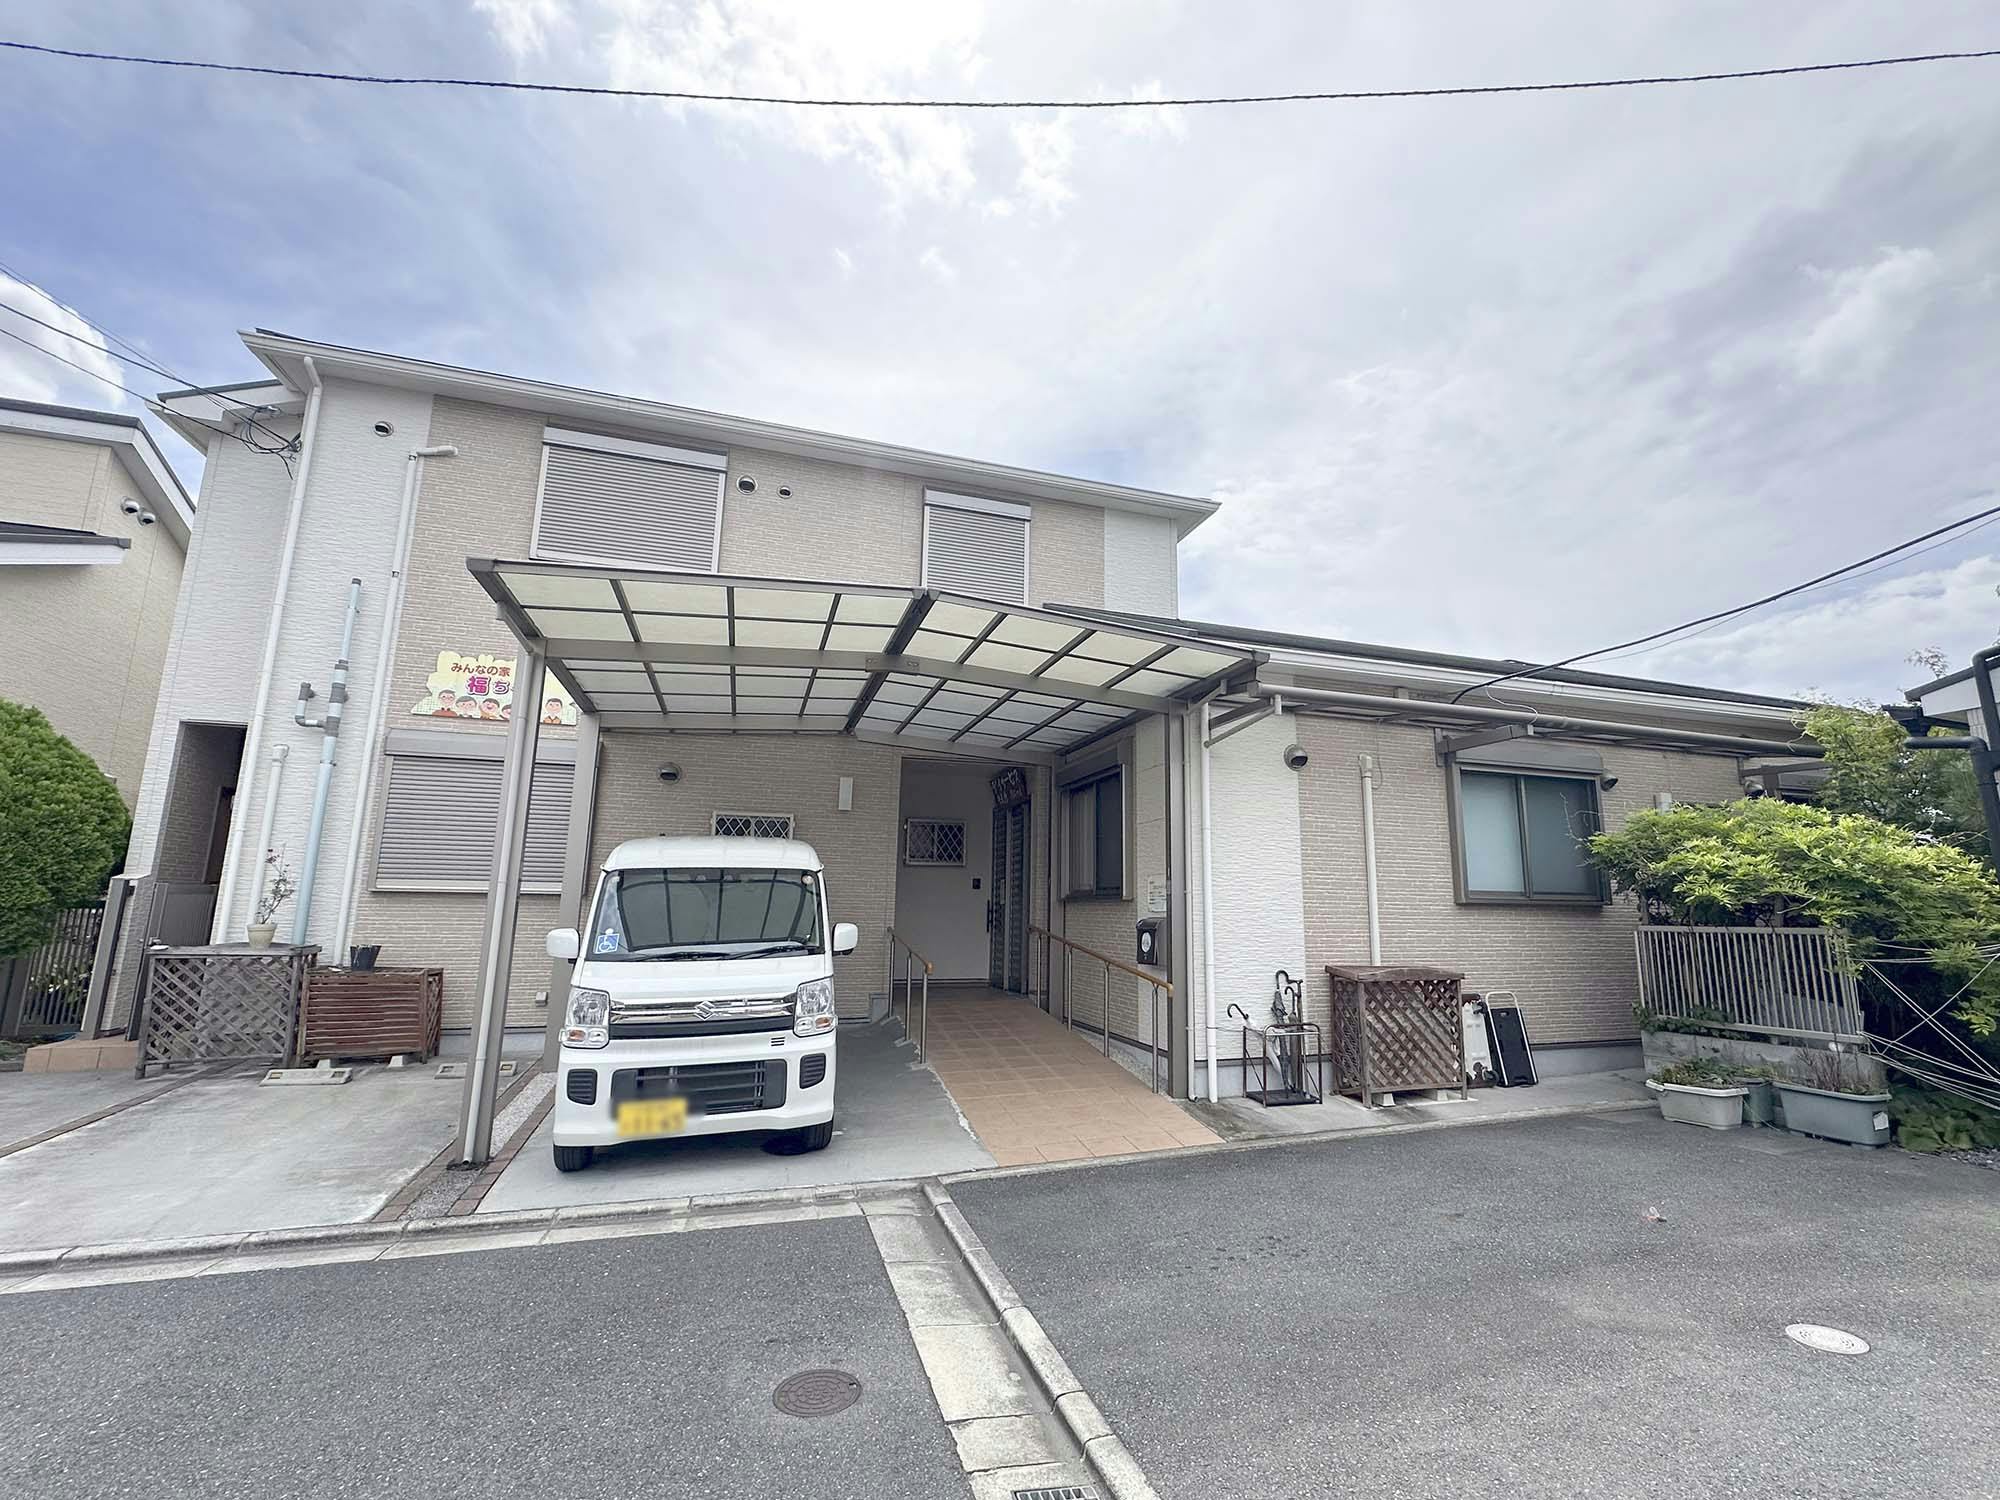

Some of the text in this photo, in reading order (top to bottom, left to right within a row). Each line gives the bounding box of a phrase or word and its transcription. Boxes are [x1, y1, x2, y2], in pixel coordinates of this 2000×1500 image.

[451, 662, 511, 677] みんなの家
[466, 675, 513, 695] 福ち
